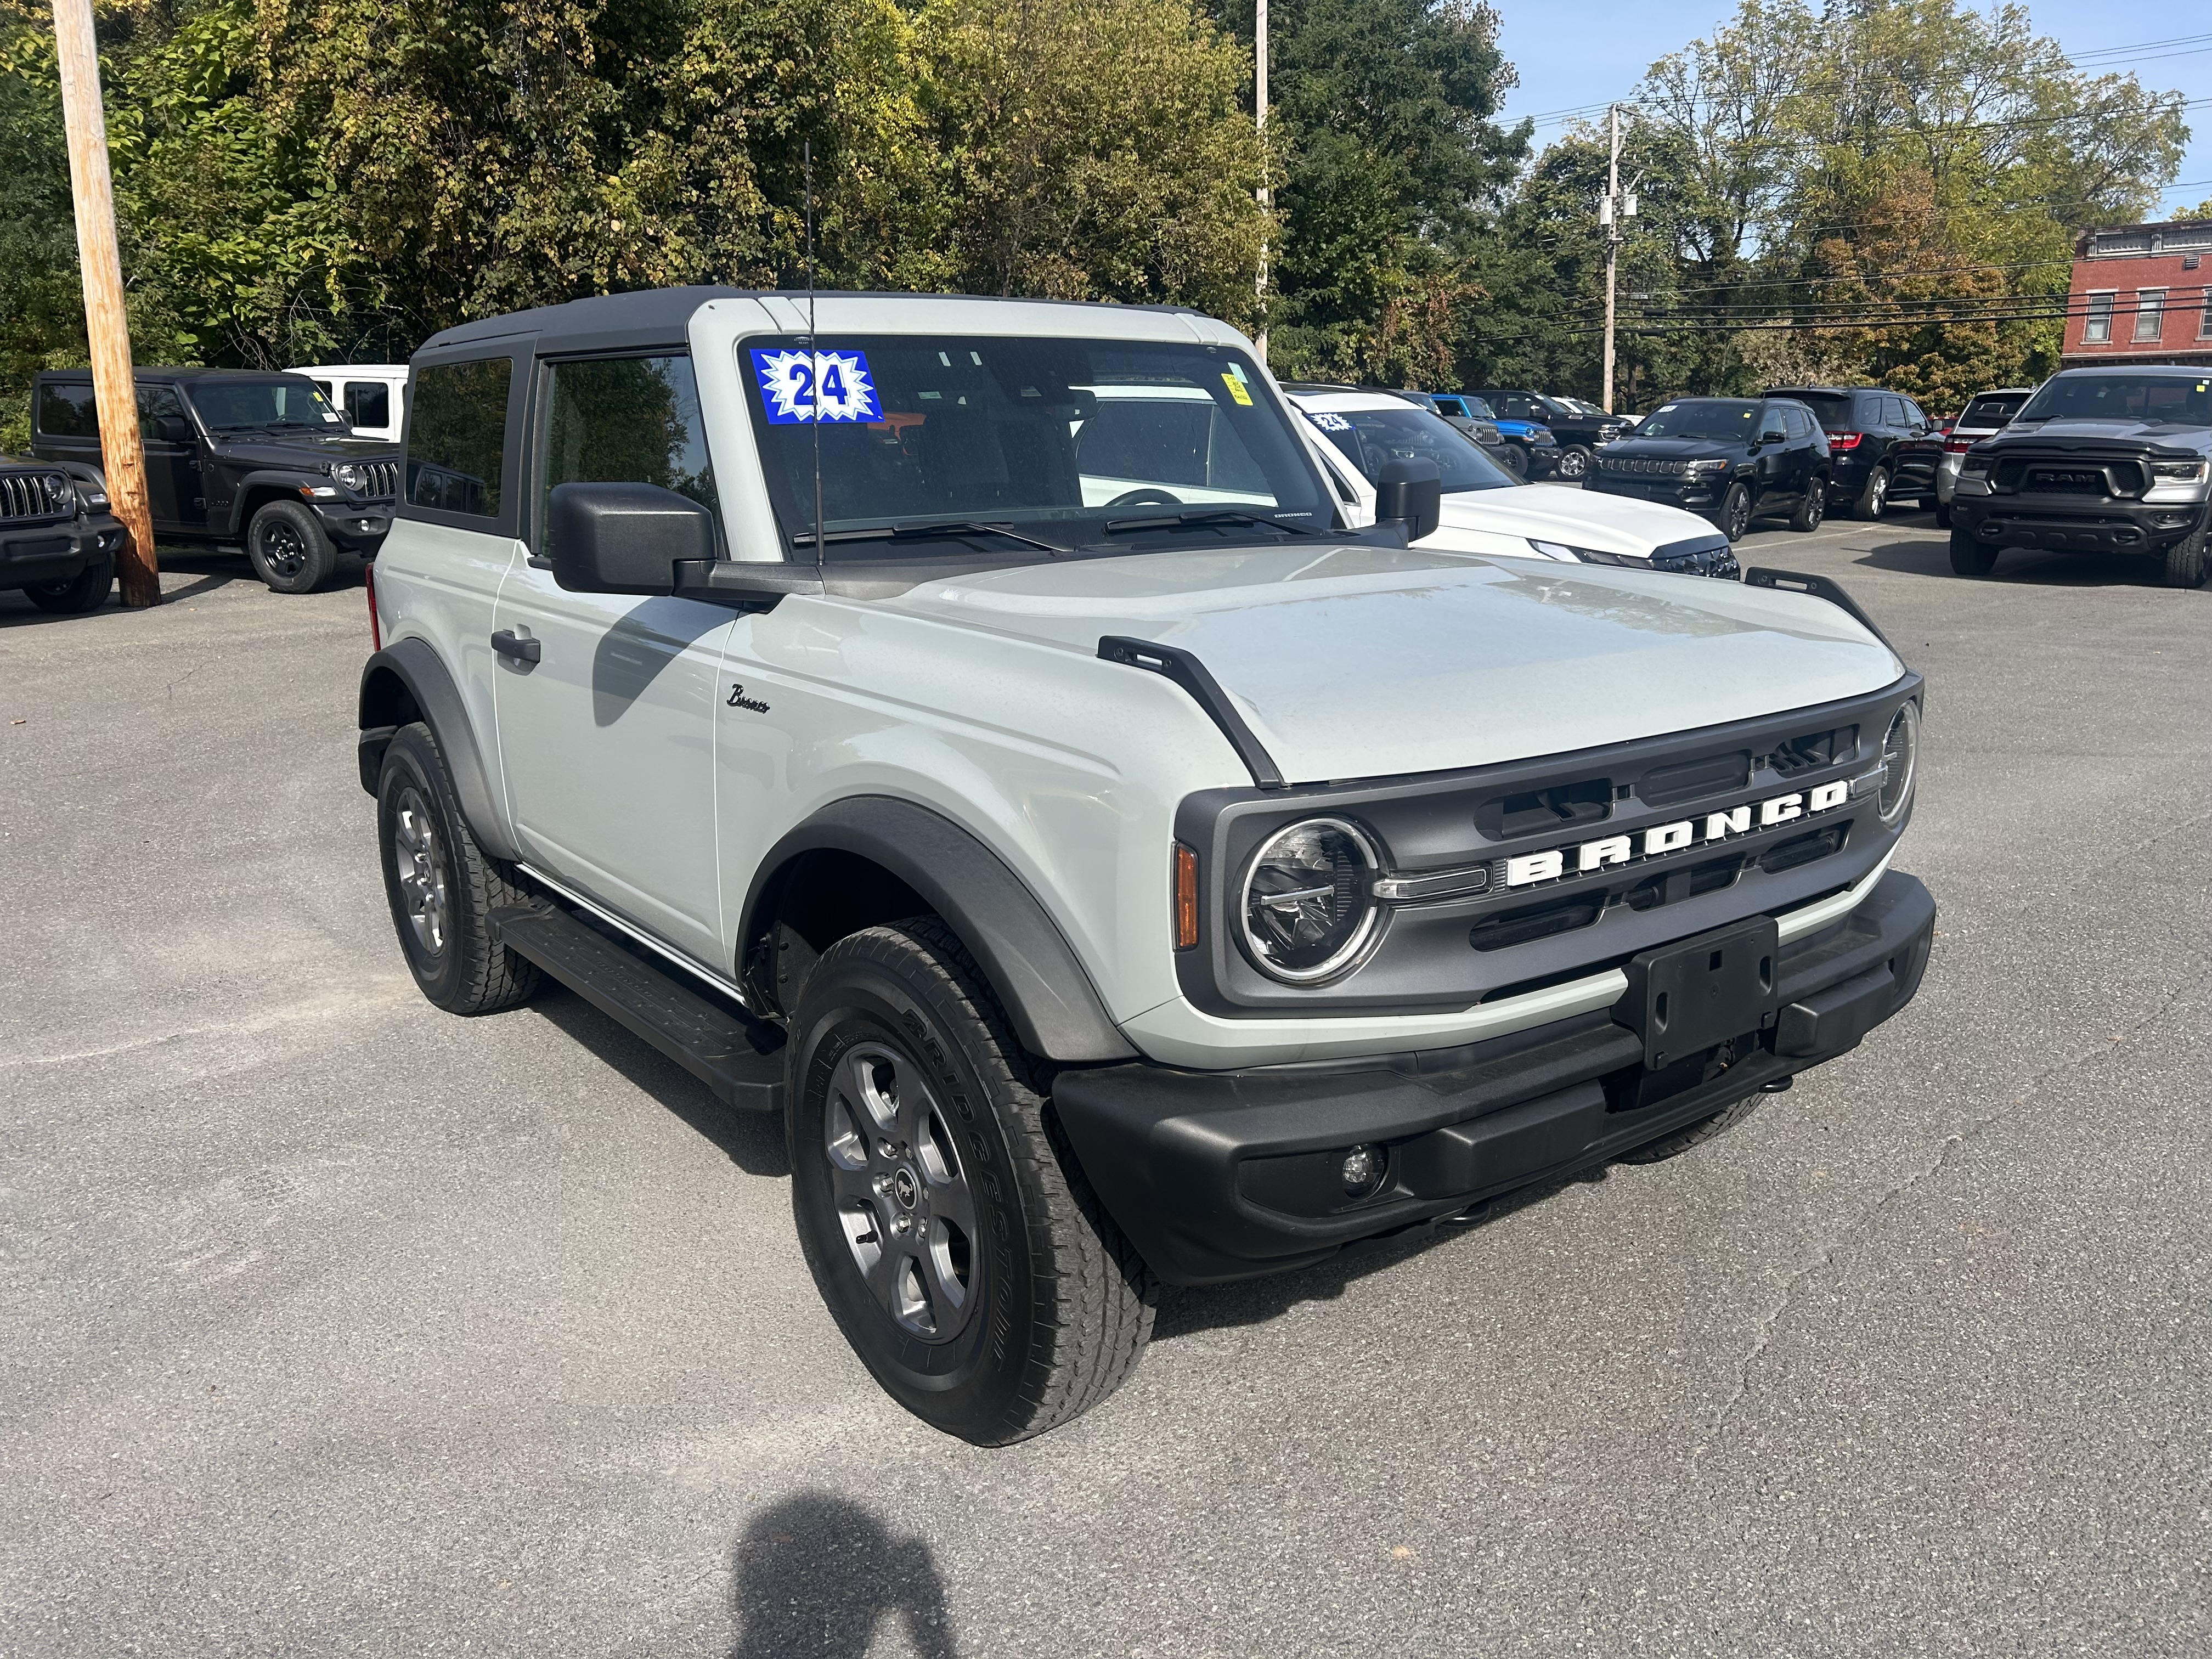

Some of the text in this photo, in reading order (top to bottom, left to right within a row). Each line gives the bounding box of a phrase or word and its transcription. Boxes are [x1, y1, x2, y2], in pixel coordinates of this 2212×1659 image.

[789, 364, 847, 405] 24
[1321, 416, 1343, 427] 24
[2036, 473, 2096, 482] RAM
[726, 684, 771, 714] Bronco
[1507, 780, 1847, 886] BRONCO
